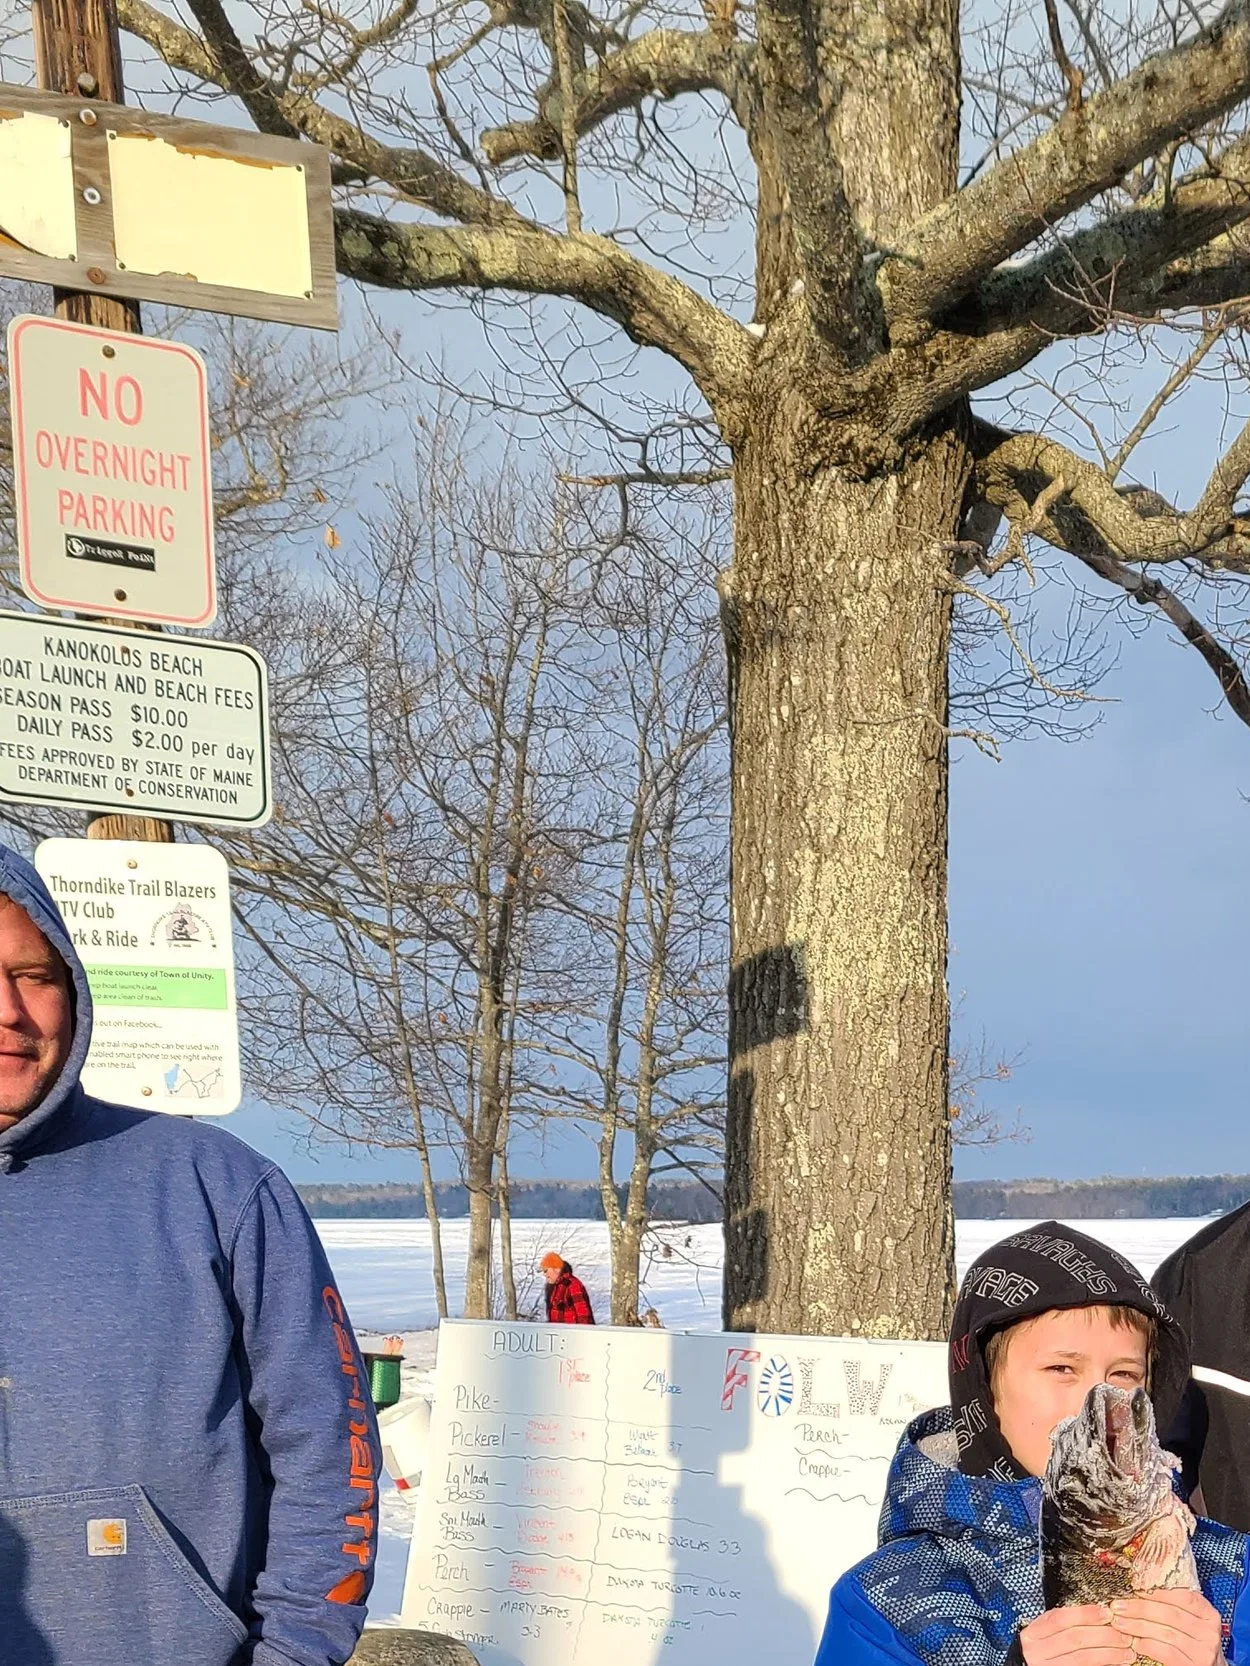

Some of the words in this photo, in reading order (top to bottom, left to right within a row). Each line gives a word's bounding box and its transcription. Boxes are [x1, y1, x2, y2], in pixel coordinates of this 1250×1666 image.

[78, 367, 143, 426] NO
[36, 430, 191, 492] OVERNIGHT
[57, 488, 175, 543] PARKING
[0, 657, 32, 680] OAT
[40, 662, 107, 690] LAUNCH
[114, 674, 147, 695] AND
[155, 679, 207, 704] BEACH
[215, 687, 254, 710] FEES
[150, 652, 203, 677] BEACH
[0, 687, 62, 712] EASON
[70, 696, 112, 718] PASS
[130, 703, 188, 728] $10.00
[17, 714, 63, 737] DAILY
[71, 721, 113, 743] PASS
[132, 729, 183, 753] $2.00
[192, 740, 218, 757] per
[226, 742, 255, 766] day
[0, 742, 35, 761] FEES
[42, 747, 115, 770] APPROVED
[122, 758, 139, 773] BY
[145, 761, 183, 779] STATE
[190, 766, 207, 781] OF
[213, 769, 254, 787] MAINE
[18, 765, 108, 791] DEPARTMENT
[115, 777, 132, 792] OF
[138, 780, 238, 804] CONSERVATION
[50, 875, 125, 895] Thorndike
[128, 879, 160, 897] Trail
[165, 880, 216, 899] Blazers
[57, 900, 79, 917] TV
[83, 901, 115, 919] Club
[73, 928, 87, 945] rk
[91, 929, 102, 946] &
[107, 930, 138, 947] Ride
[115, 970, 148, 978] courtesy
[493, 1330, 566, 1353] ADULT:
[658, 1533, 710, 1551] DOUGLAS
